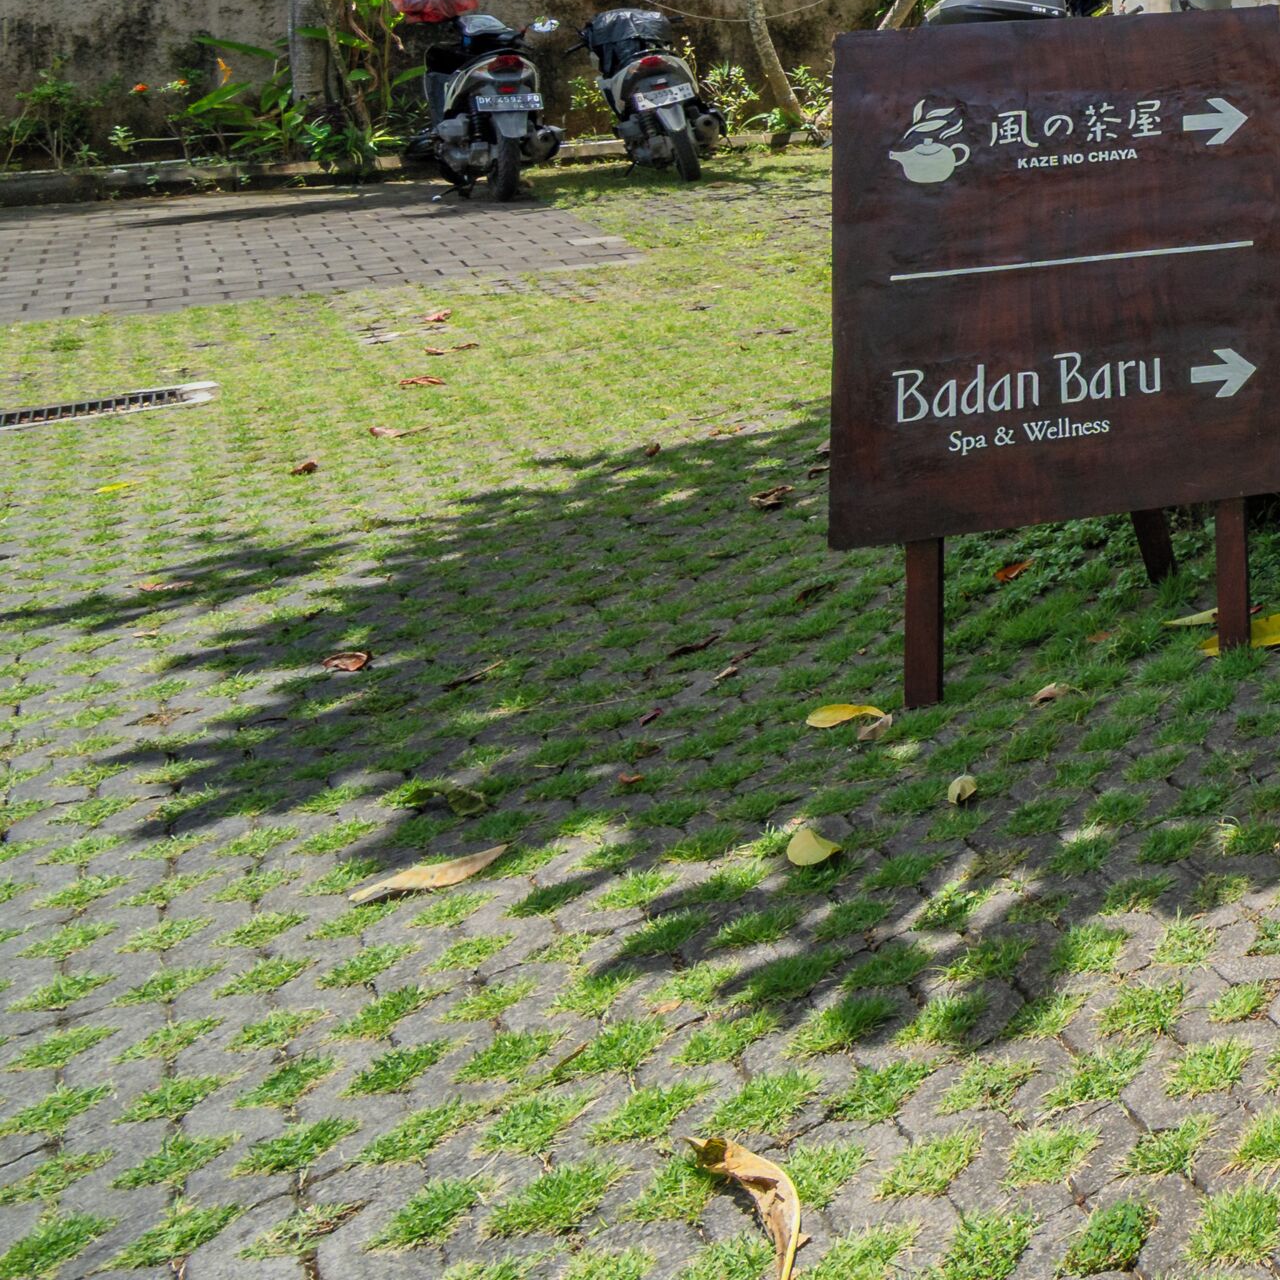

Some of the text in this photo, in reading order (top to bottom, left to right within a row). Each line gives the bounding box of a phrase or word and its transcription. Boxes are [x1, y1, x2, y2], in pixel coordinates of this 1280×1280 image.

[989, 100, 1162, 148] 風の茶屋
[1017, 148, 1138, 169] KAZE NO CHAYA
[892, 351, 1161, 423] Badan Baru
[948, 417, 1110, 456] Spa & Wellness
